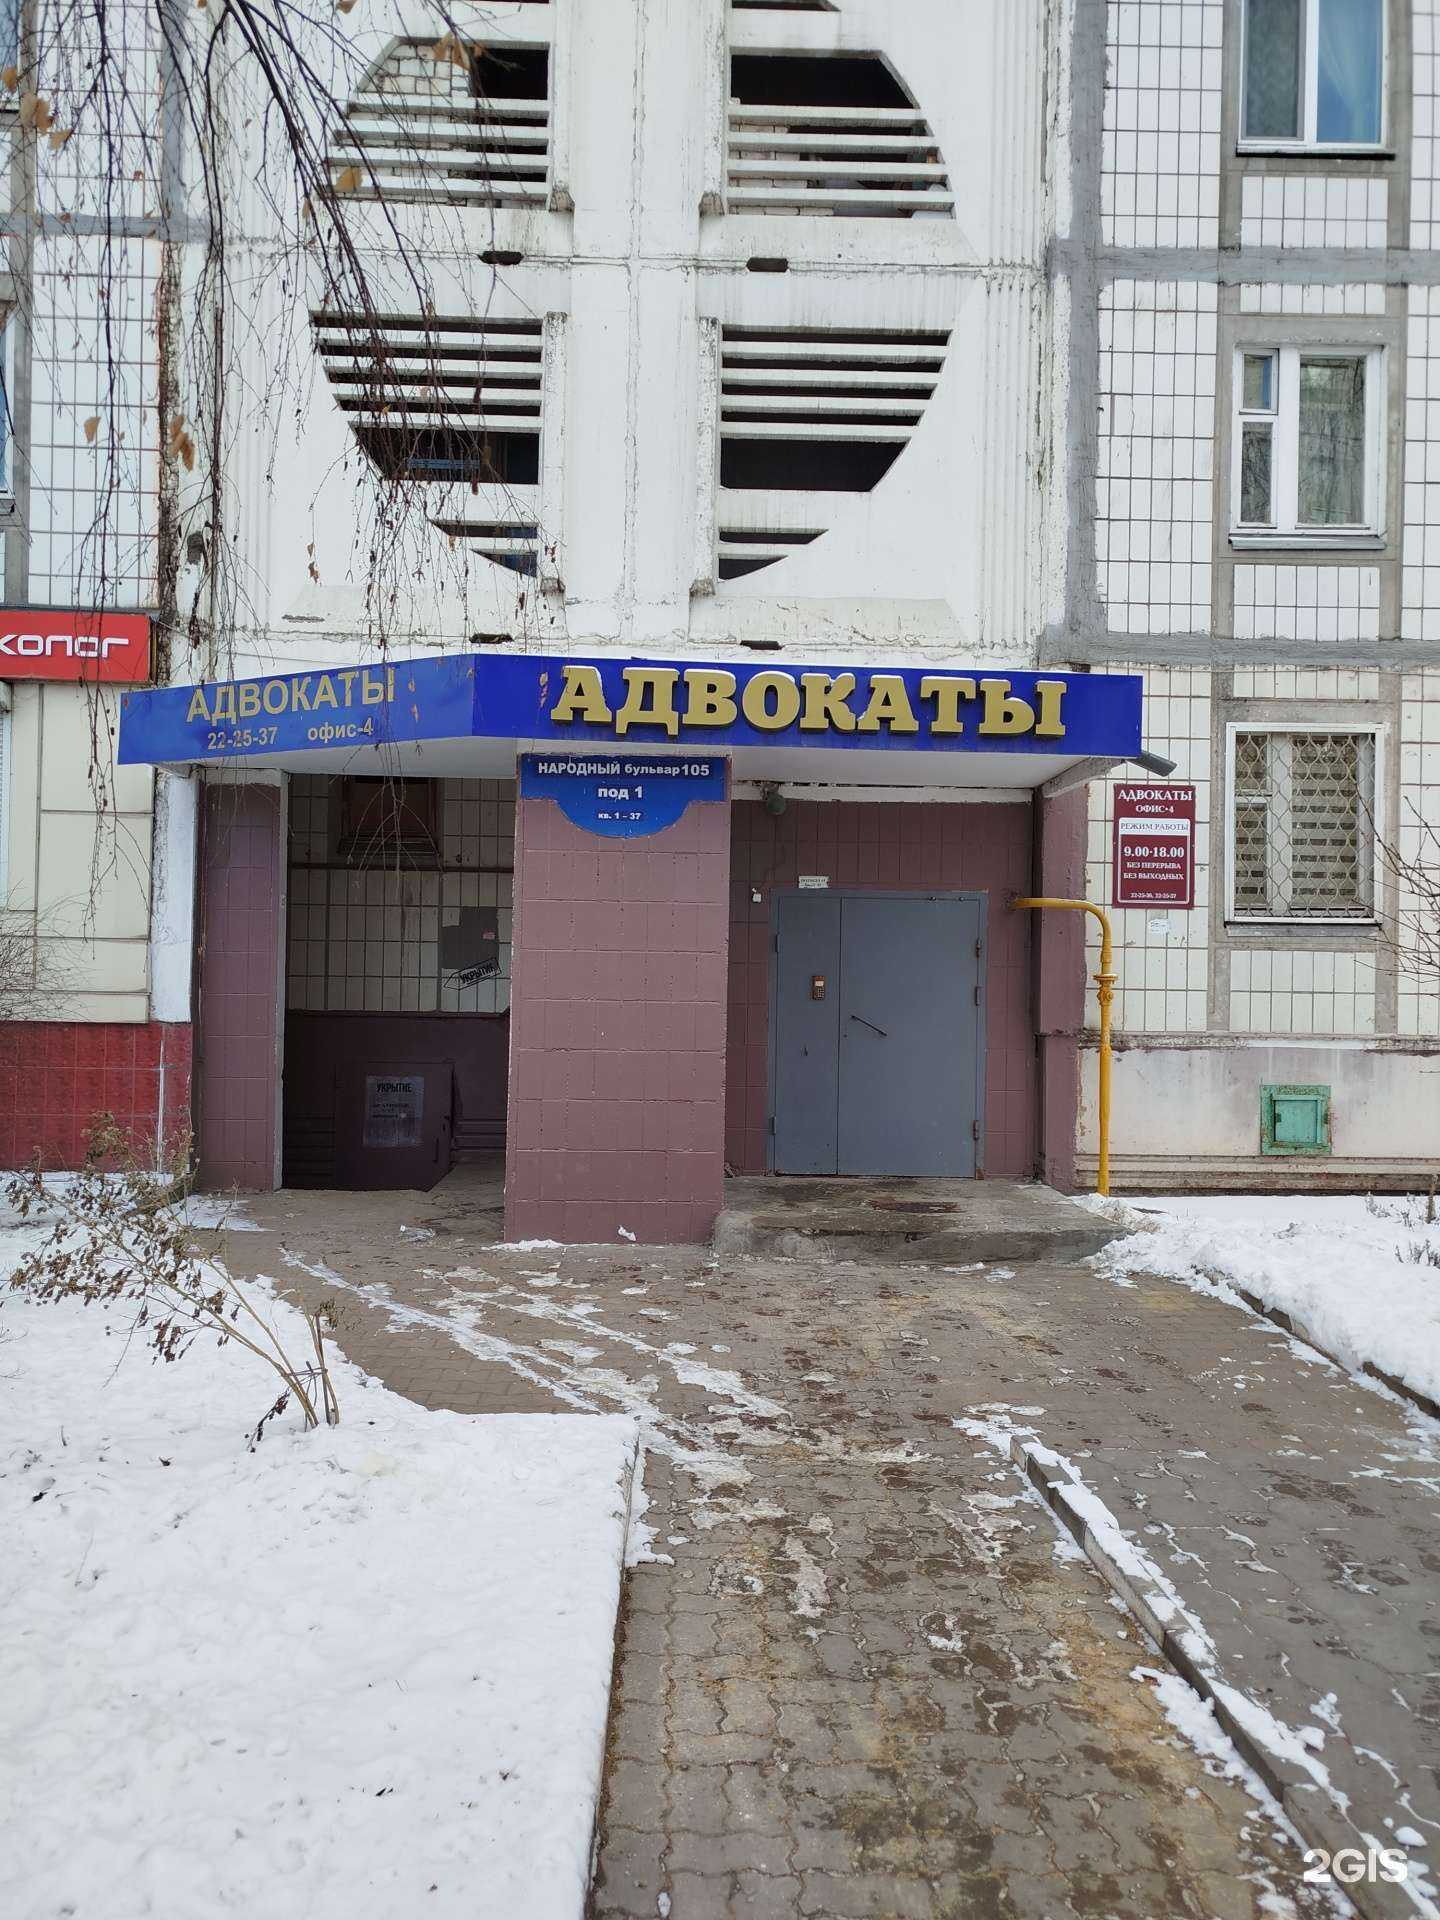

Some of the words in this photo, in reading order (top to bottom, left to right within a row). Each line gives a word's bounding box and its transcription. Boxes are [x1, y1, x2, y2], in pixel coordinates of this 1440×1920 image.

[186, 667, 397, 727] АДВОКАТЫ
[550, 665, 1067, 736] АДВОКАТЫ
[207, 726, 279, 750] 22-25-37
[307, 716, 374, 743] офис-4
[538, 761, 621, 775] НАРОДНЫЙ
[624, 763, 680, 777] бульвар
[682, 764, 710, 776] 105
[598, 787, 630, 799] под
[634, 786, 643, 798] 1
[1118, 789, 1193, 802] АДВОКАТЫ
[598, 812, 612, 820] кв.
[614, 812, 620, 820] 1
[629, 812, 642, 820] 37
[1120, 822, 1152, 830] РЕЖИМ
[1153, 823, 1188, 831] РАБОТЫ
[1141, 862, 1182, 870] ПЕРЕРЫВА
[1123, 872, 1138, 880] БЕЗ
[1138, 872, 1185, 881] ВЫХОДНЫХ
